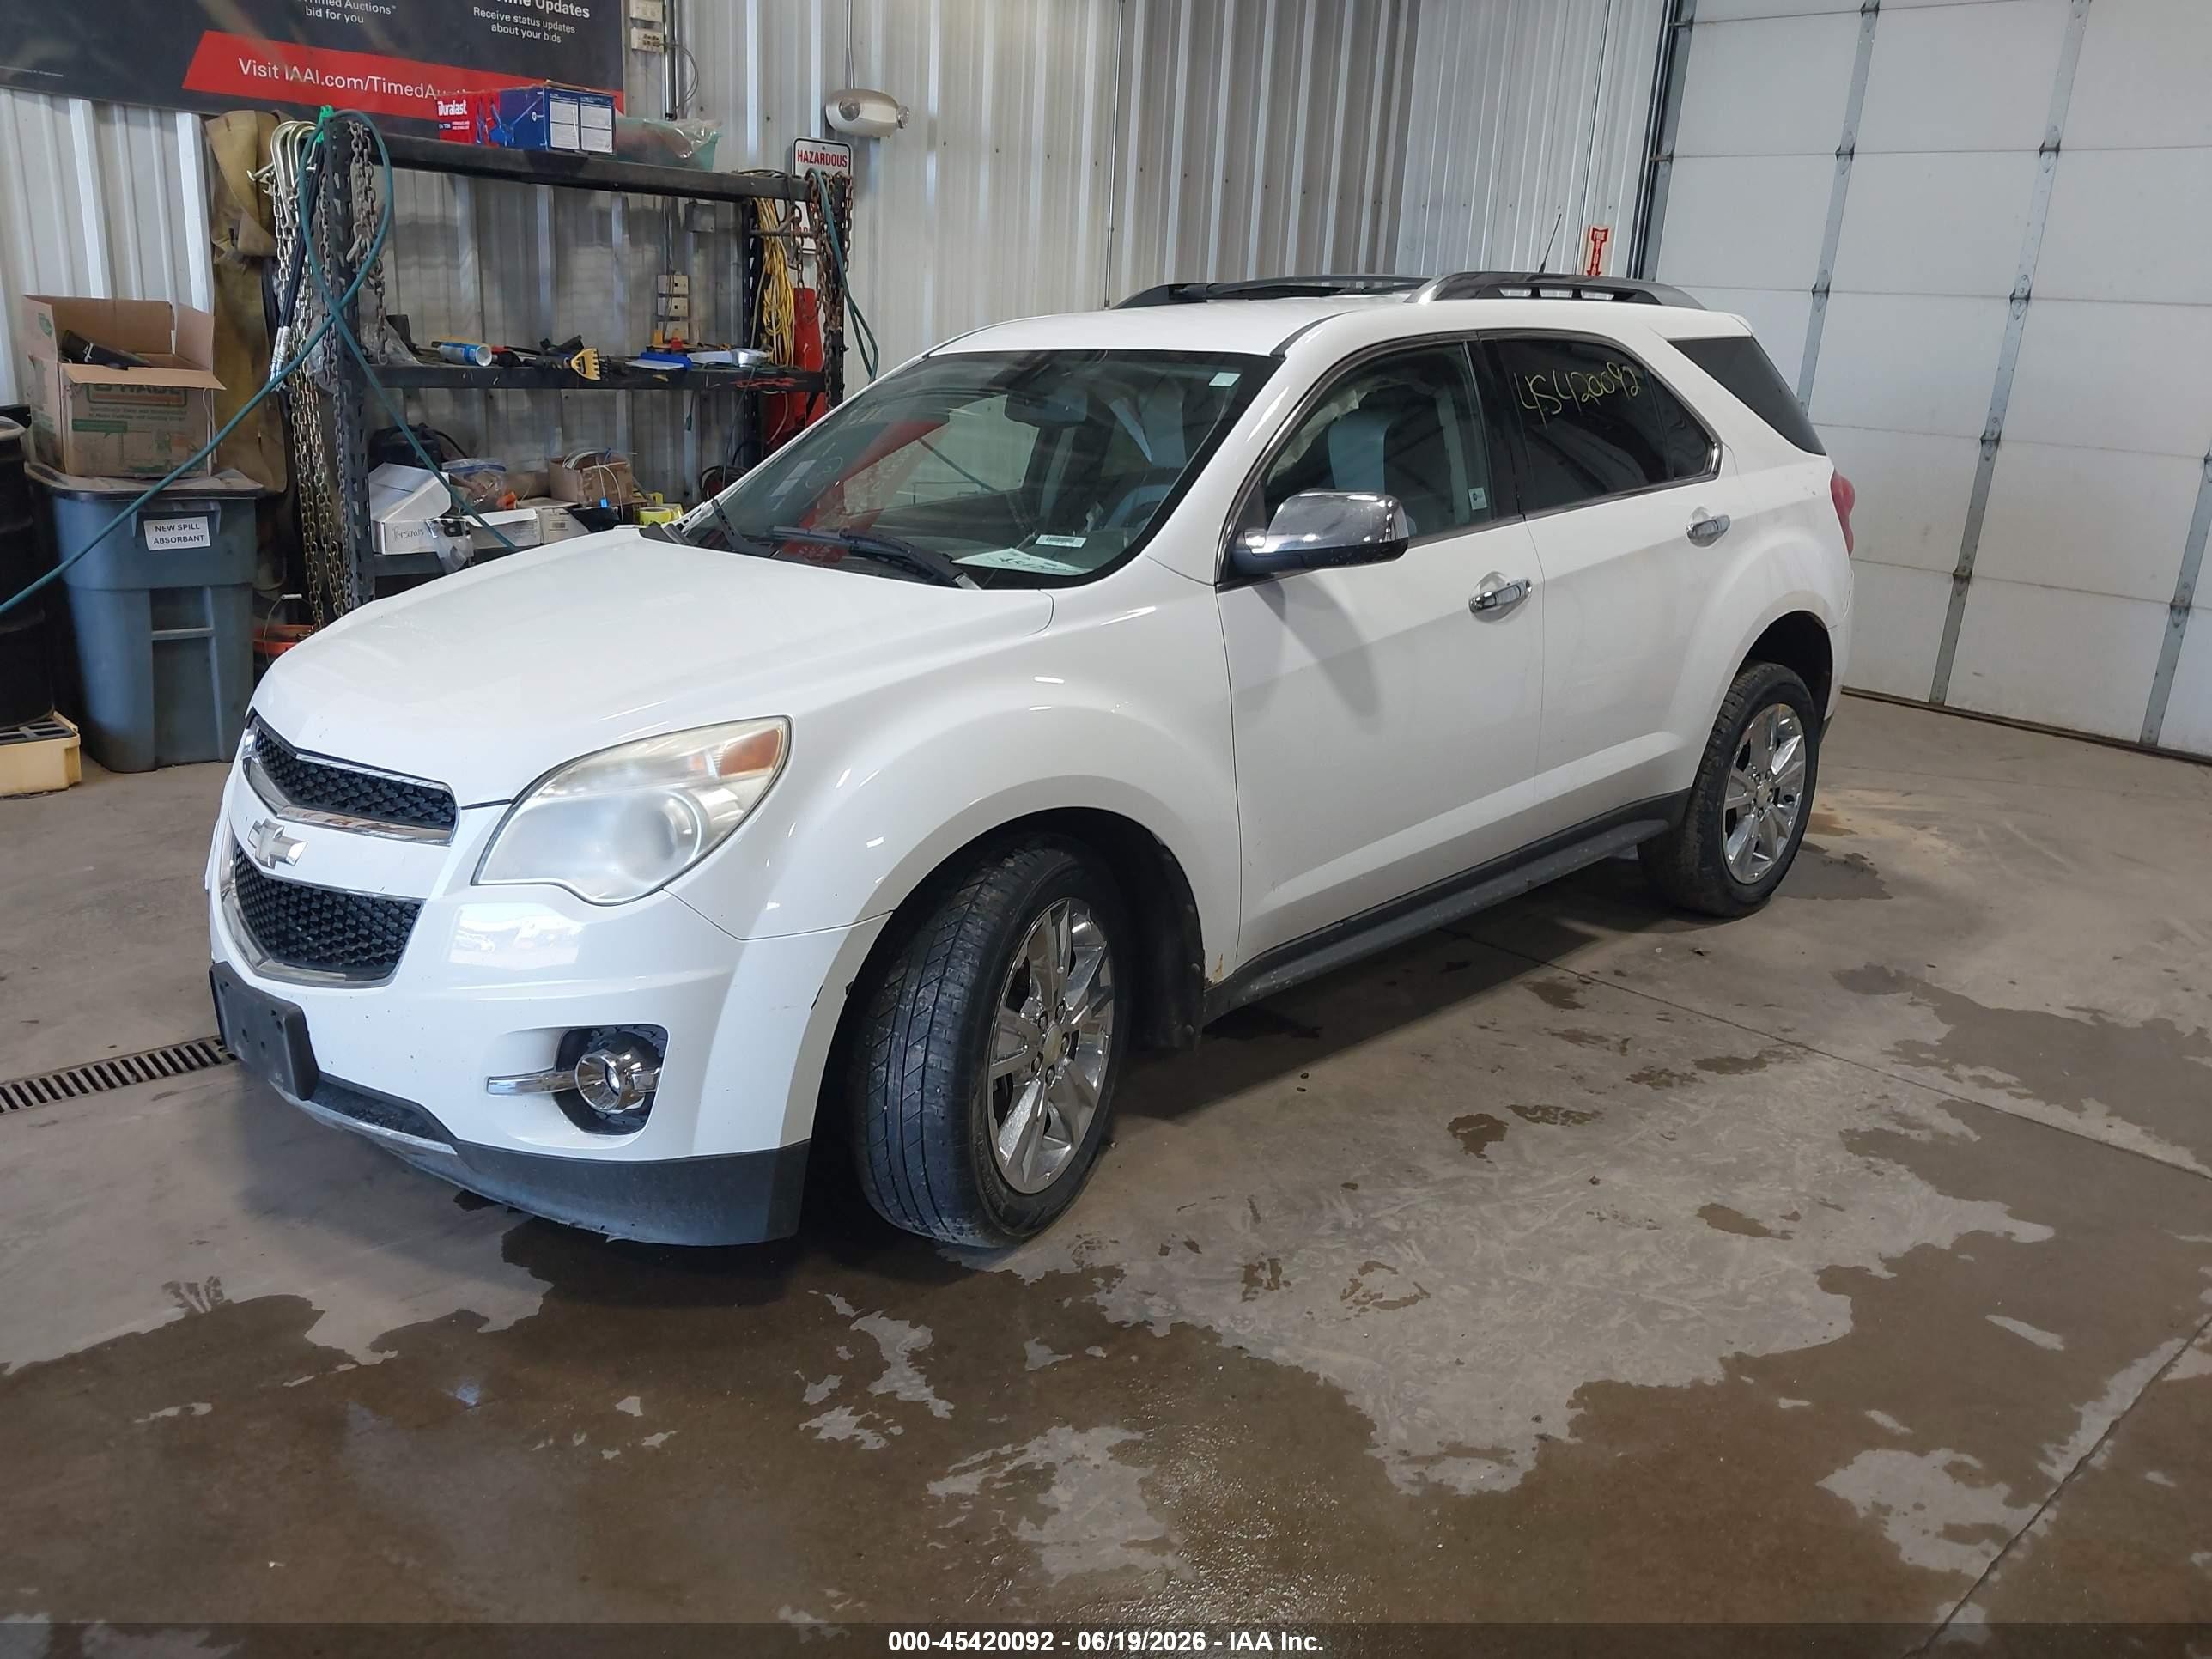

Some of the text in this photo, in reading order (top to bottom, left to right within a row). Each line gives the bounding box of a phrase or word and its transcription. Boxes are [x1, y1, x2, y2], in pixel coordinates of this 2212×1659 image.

[305, 6, 364, 23] bid for you
[473, 7, 575, 33] Receive status updates
[491, 23, 562, 43] about your bids
[238, 58, 279, 80] Visit
[437, 99, 468, 116] Duralast
[797, 149, 848, 167] HAZARDOUS
[1513, 362, 1641, 427] 45420092
[153, 534, 204, 544] ABSORBANT
